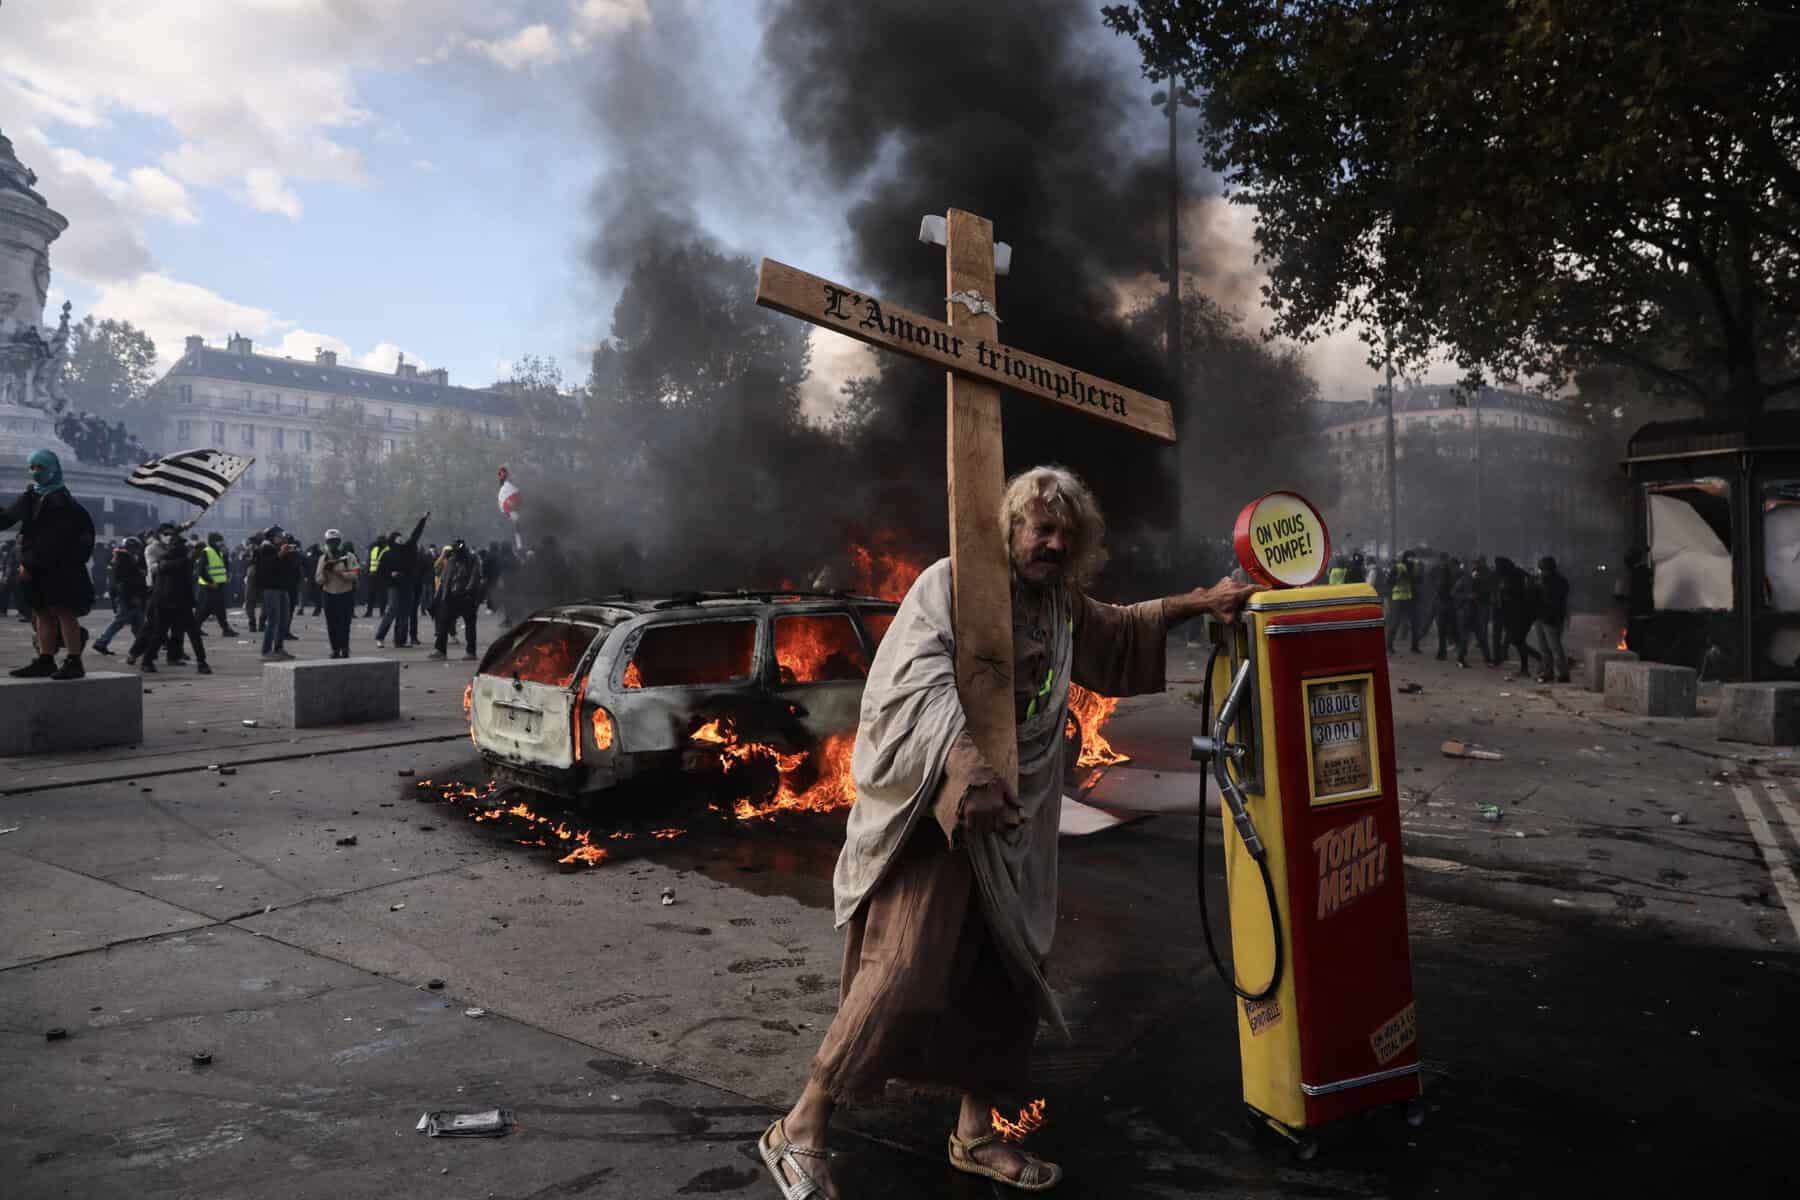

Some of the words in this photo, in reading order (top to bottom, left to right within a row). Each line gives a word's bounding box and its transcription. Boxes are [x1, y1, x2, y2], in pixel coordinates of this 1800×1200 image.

[823, 284, 965, 359] L'Amour
[975, 340, 1130, 417] triomphera
[1256, 523, 1273, 545] ON
[1273, 513, 1305, 539] VOUS
[1264, 532, 1313, 568] POMPE!
[1312, 816, 1379, 877] TOTAL
[1317, 842, 1389, 920] MENT!
